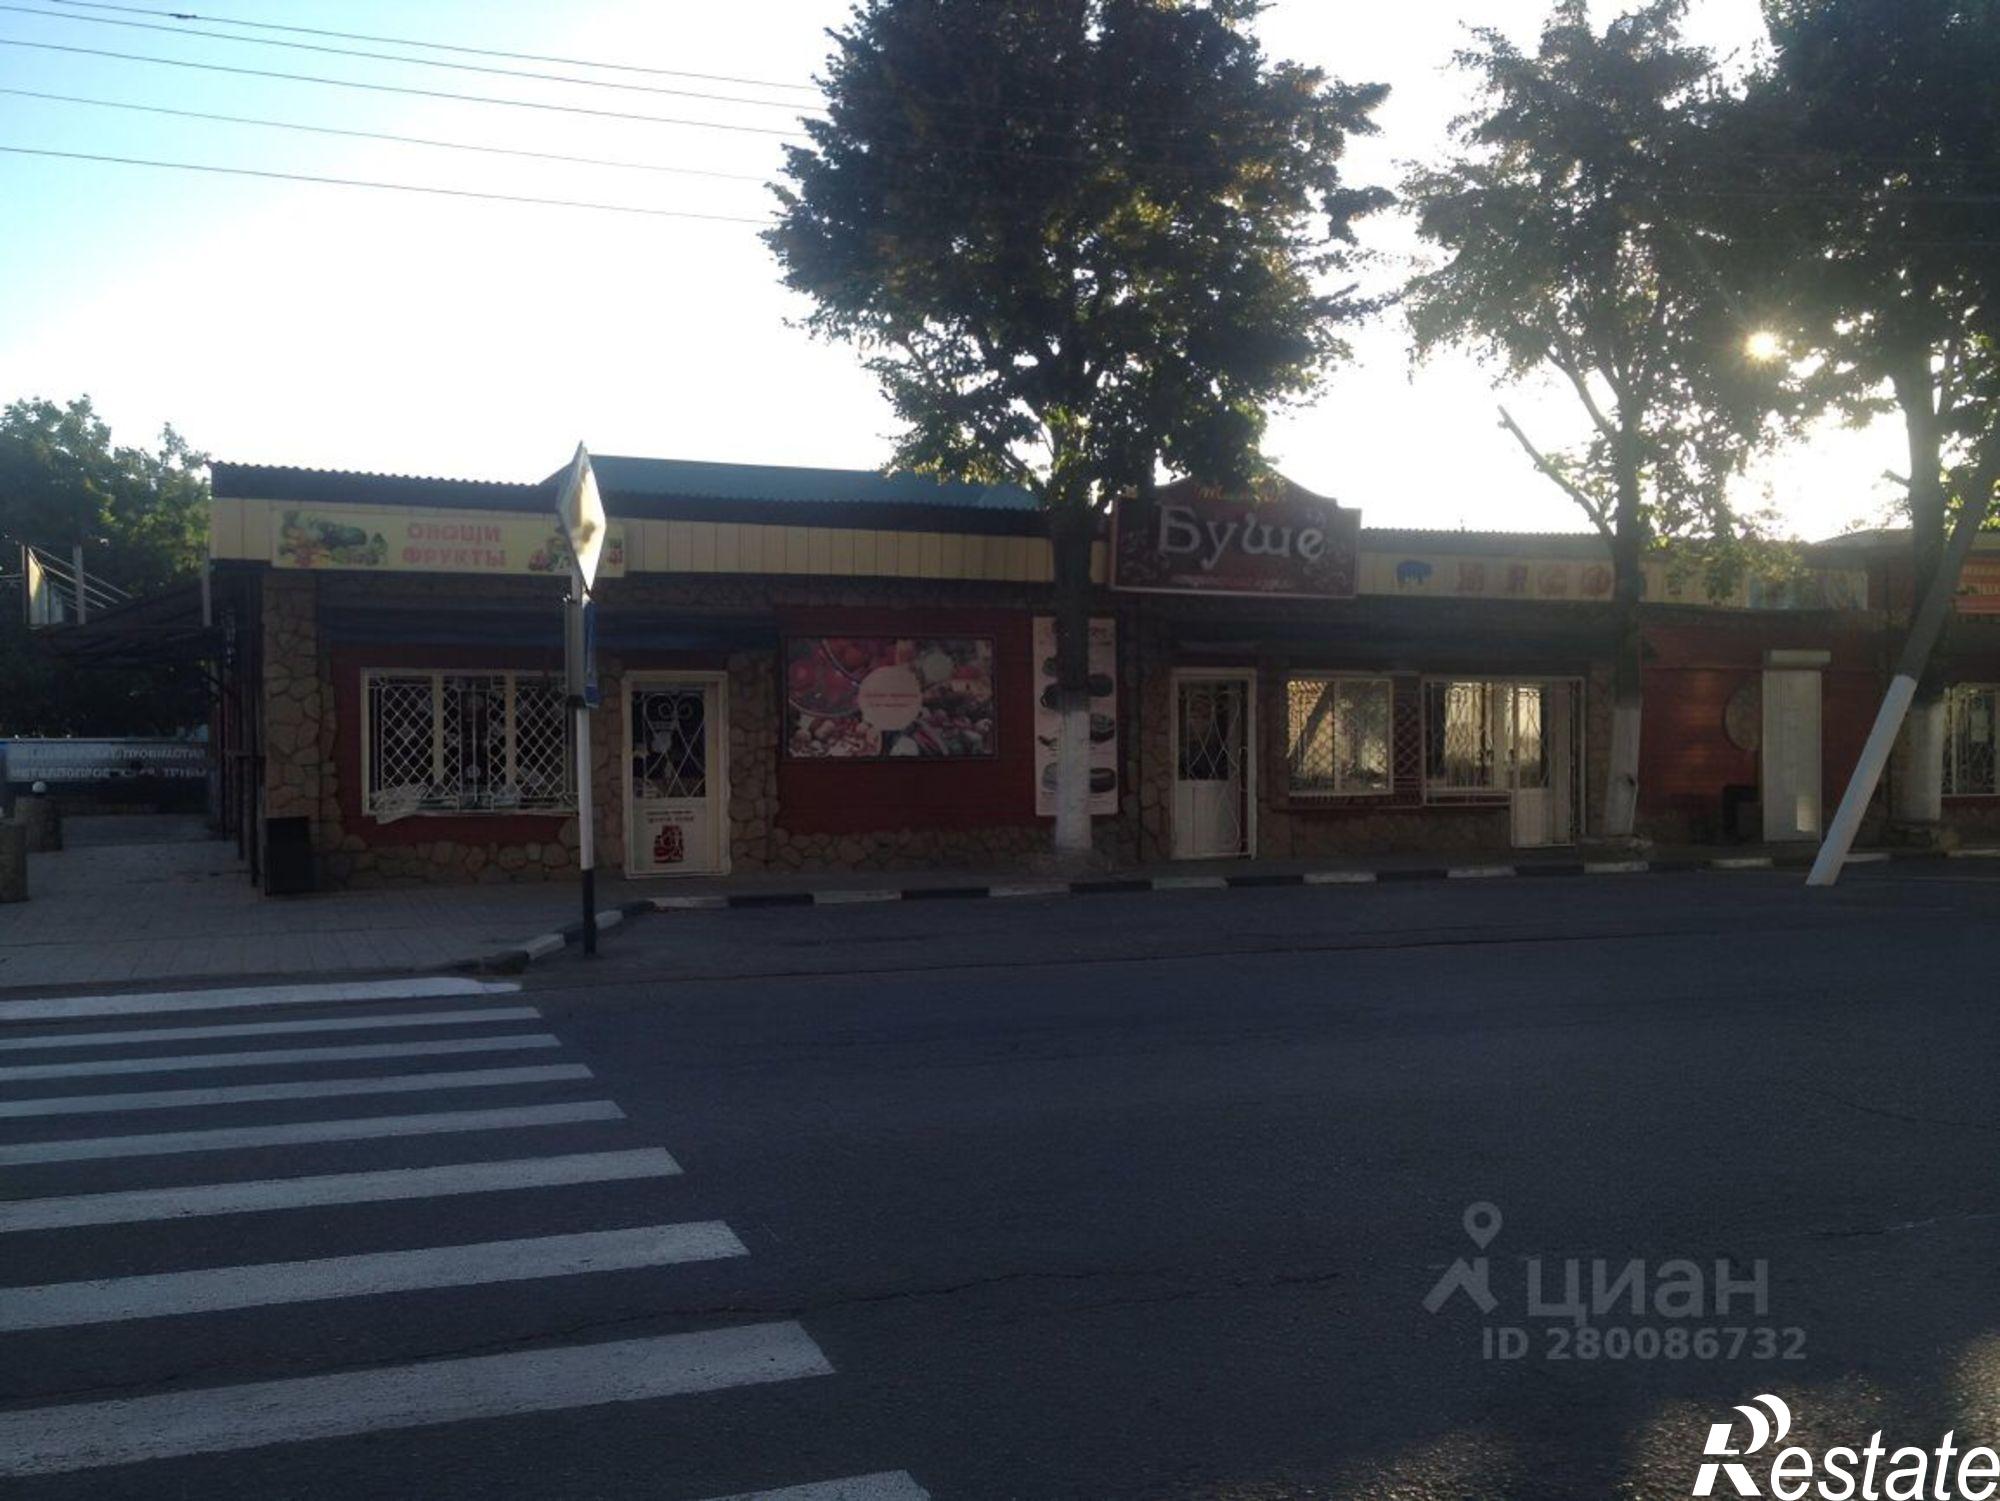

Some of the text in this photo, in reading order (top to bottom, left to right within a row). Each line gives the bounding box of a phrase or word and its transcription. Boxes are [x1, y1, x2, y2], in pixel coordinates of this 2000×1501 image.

[407, 522, 502, 544] ОВОЩИ
[1156, 501, 1324, 570] Буше
[402, 546, 506, 567] ФРУКТЫ
